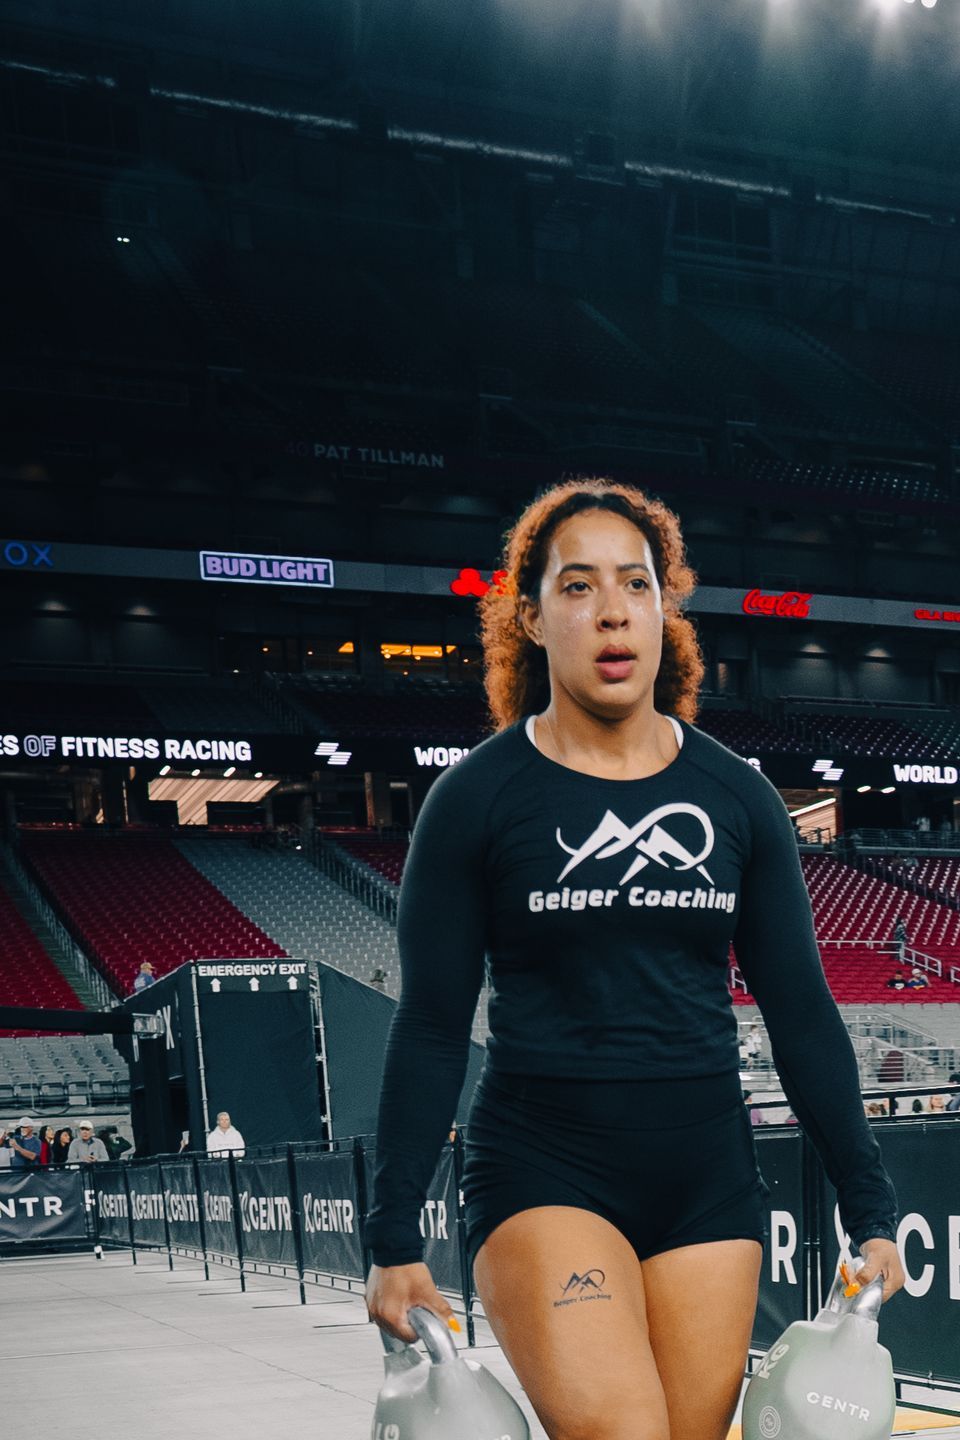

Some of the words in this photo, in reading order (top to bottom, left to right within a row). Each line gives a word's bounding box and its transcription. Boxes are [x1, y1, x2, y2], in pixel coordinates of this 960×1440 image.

[313, 443, 350, 460] PAT
[357, 447, 445, 469] TILLMAN
[205, 556, 257, 578] BUD
[258, 559, 328, 582] LIGHT
[23, 734, 56, 757] OF
[61, 736, 160, 759] FITNESS
[164, 738, 252, 761] RACING
[893, 764, 958, 784] WORLD
[528, 886, 620, 913] Geiger
[627, 886, 737, 914] Coaching
[198, 963, 277, 977] EMERGENCY
[278, 962, 308, 976] EXIT
[248, 1196, 293, 1232] CENTR
[313, 1198, 354, 1233] CENTR
[757, 1343, 790, 1380] KG
[806, 1391, 871, 1422] CENTR
